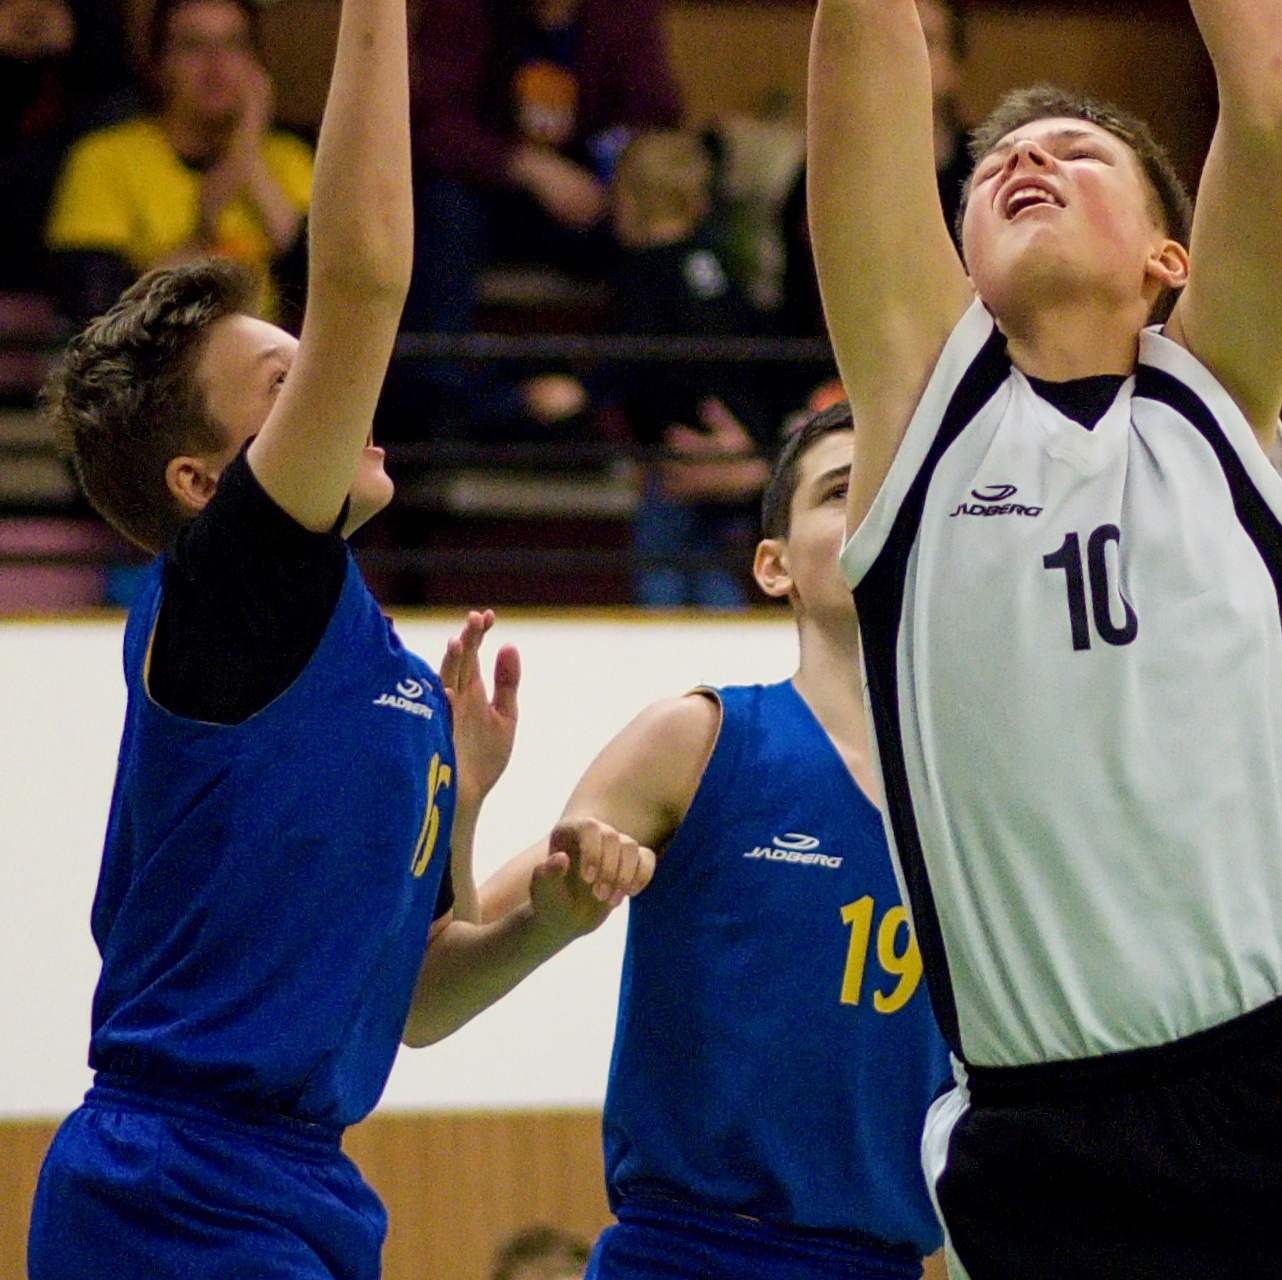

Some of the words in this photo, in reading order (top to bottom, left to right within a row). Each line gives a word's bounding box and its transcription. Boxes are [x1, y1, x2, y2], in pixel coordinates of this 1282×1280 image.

[1043, 524, 1138, 651] 10
[743, 846, 844, 869] JADBERG
[839, 894, 924, 1014] 19
